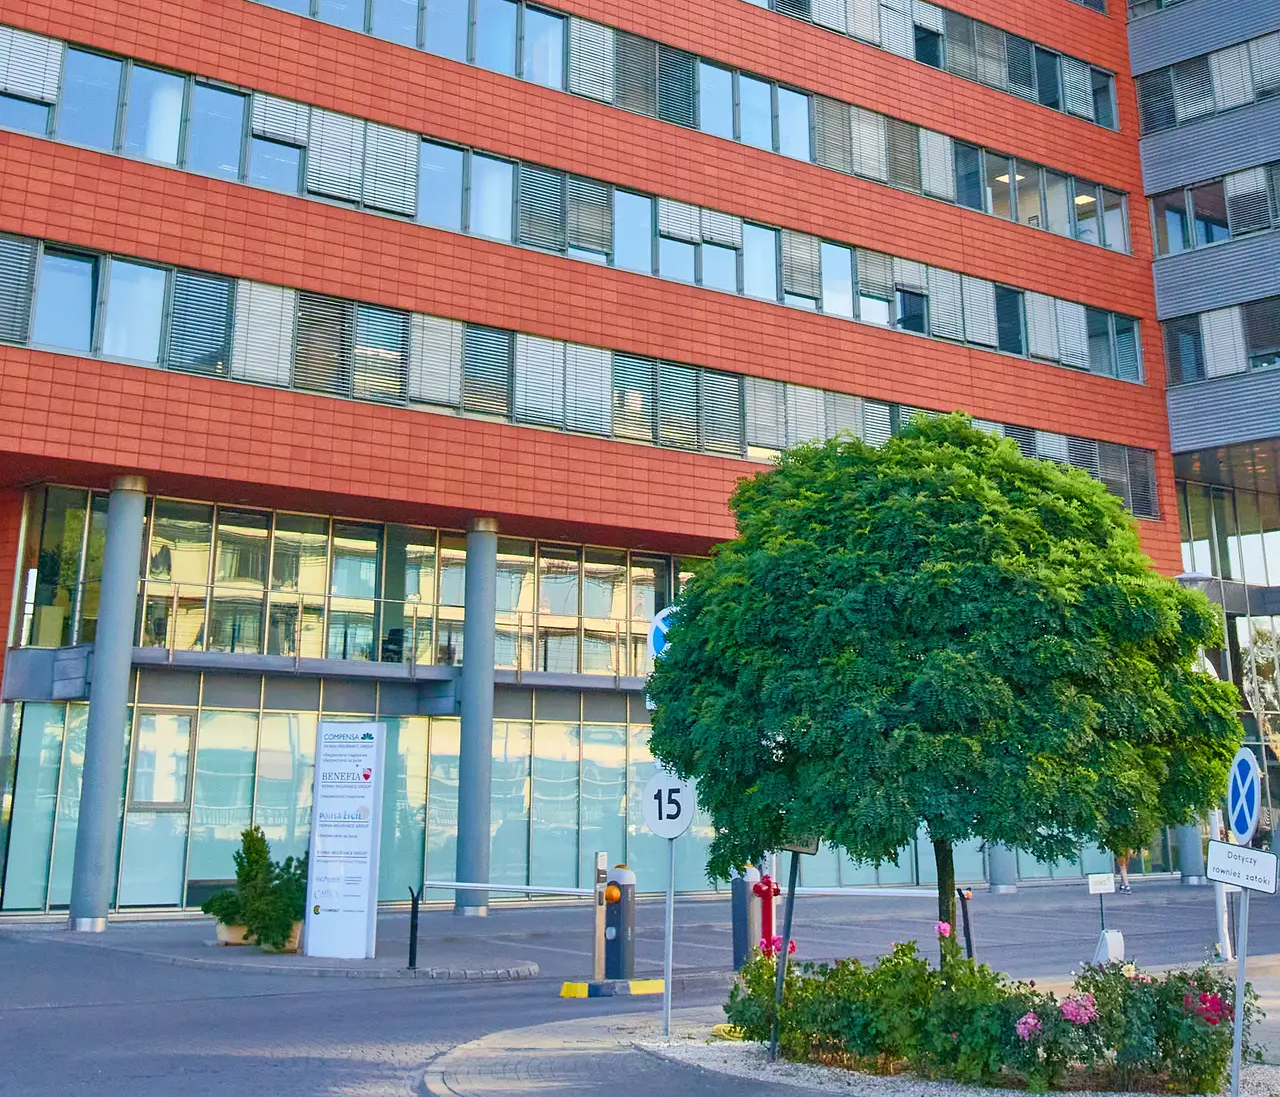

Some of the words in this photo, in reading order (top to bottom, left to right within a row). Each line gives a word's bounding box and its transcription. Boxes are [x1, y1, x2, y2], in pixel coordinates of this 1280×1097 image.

[324, 733, 360, 741] COMPENSA
[322, 772, 361, 781] BENEFIA
[654, 788, 681, 820] 15
[1227, 851, 1257, 866] Dotyczy
[1245, 874, 1271, 885] zatoki
